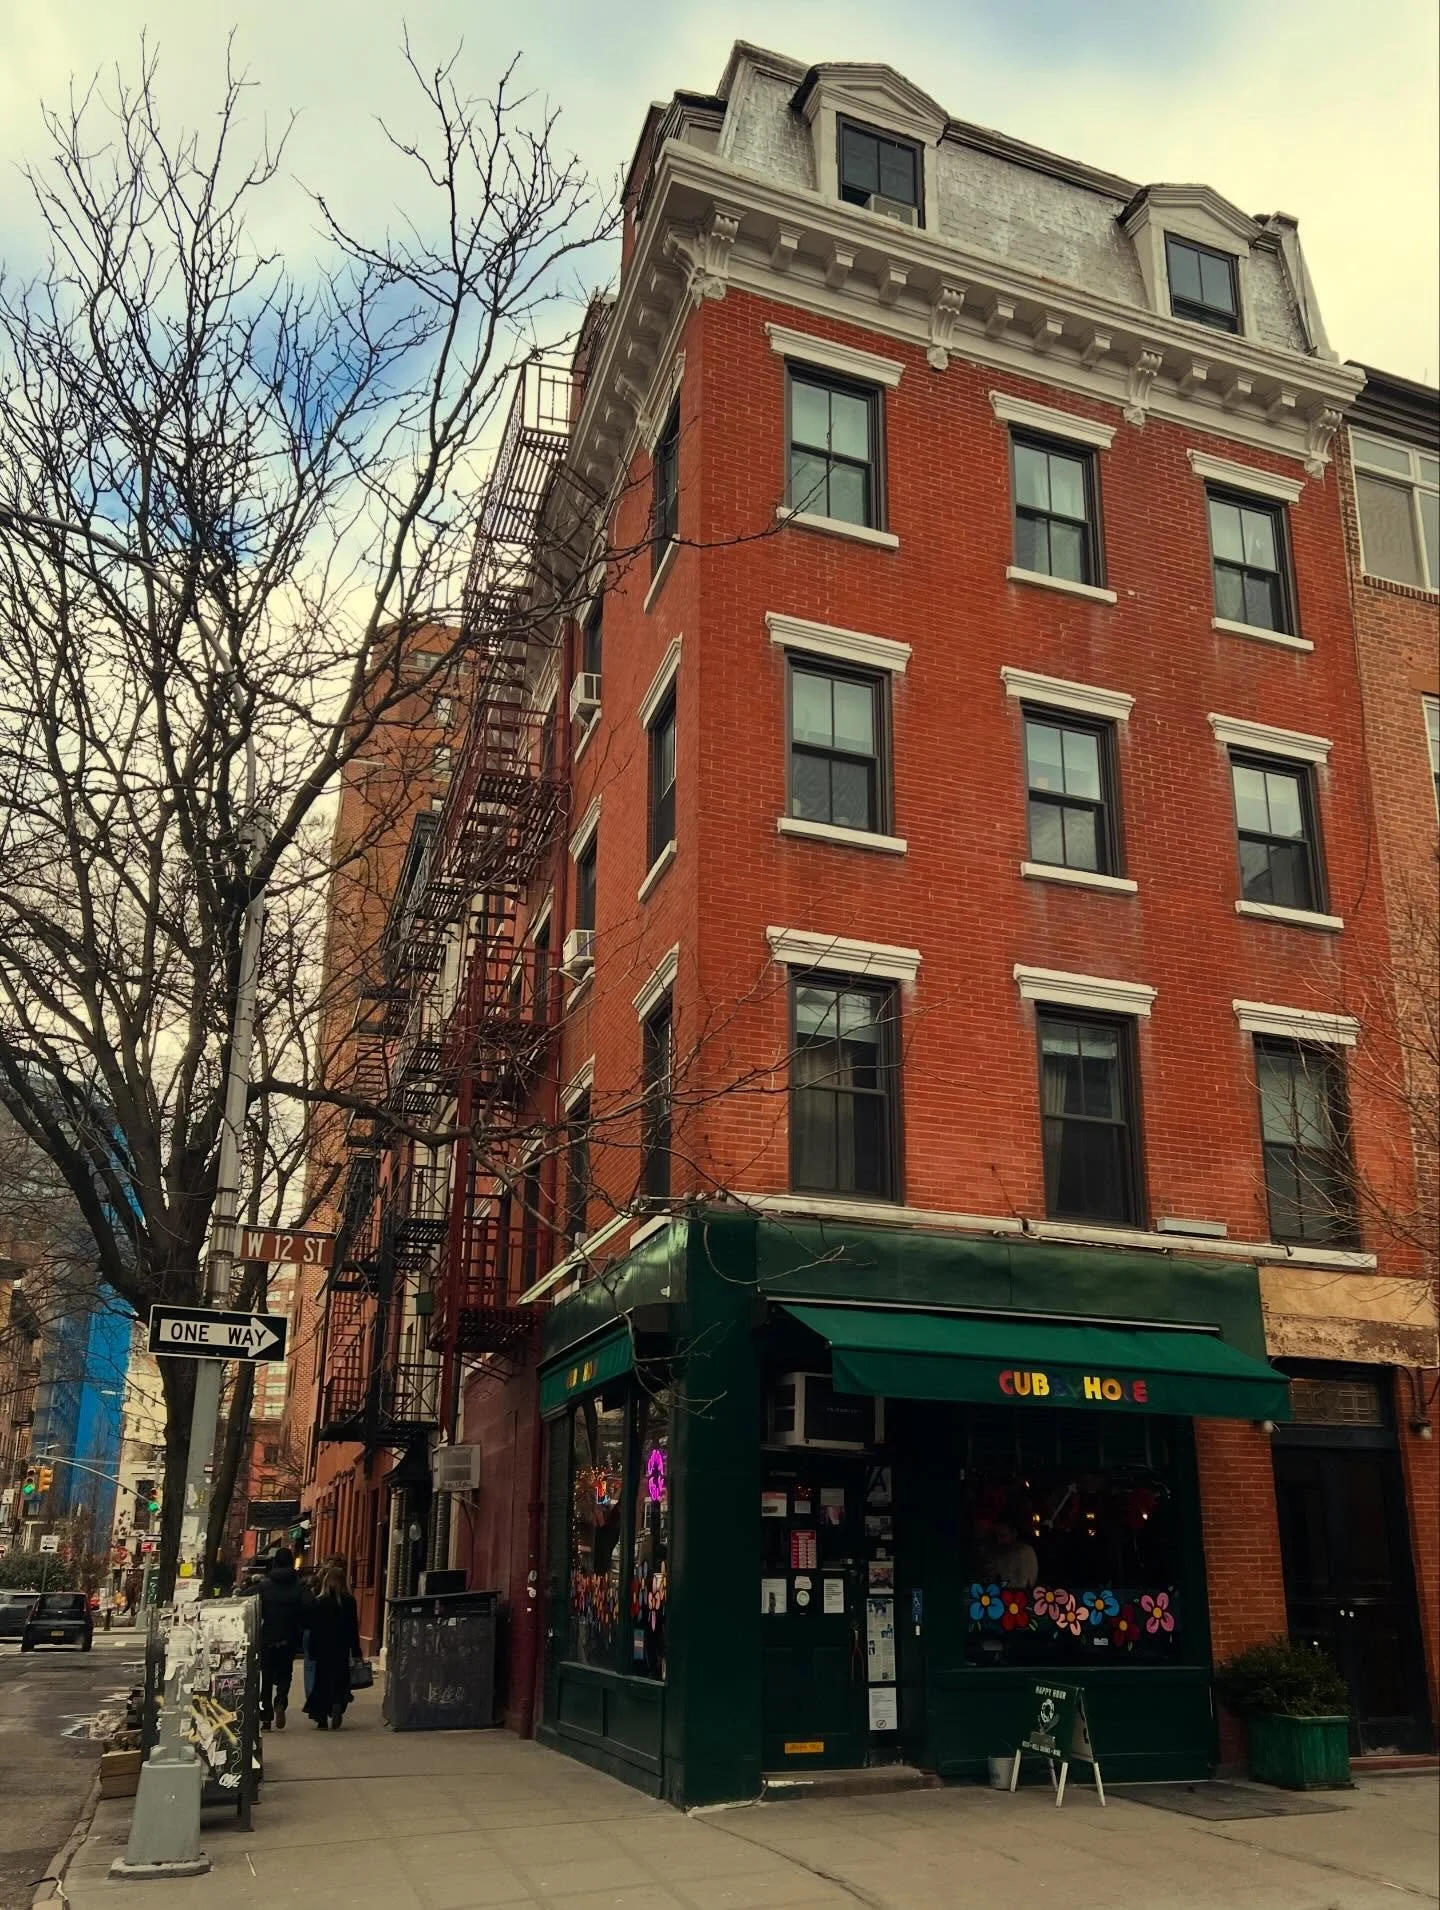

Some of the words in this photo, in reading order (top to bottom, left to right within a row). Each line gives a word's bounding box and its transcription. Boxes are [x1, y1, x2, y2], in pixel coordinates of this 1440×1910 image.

[248, 1232, 264, 1258] W
[274, 1235, 294, 1260] 12
[303, 1237, 326, 1263] ST
[171, 1322, 210, 1342] ONE
[228, 1326, 267, 1347] WAY
